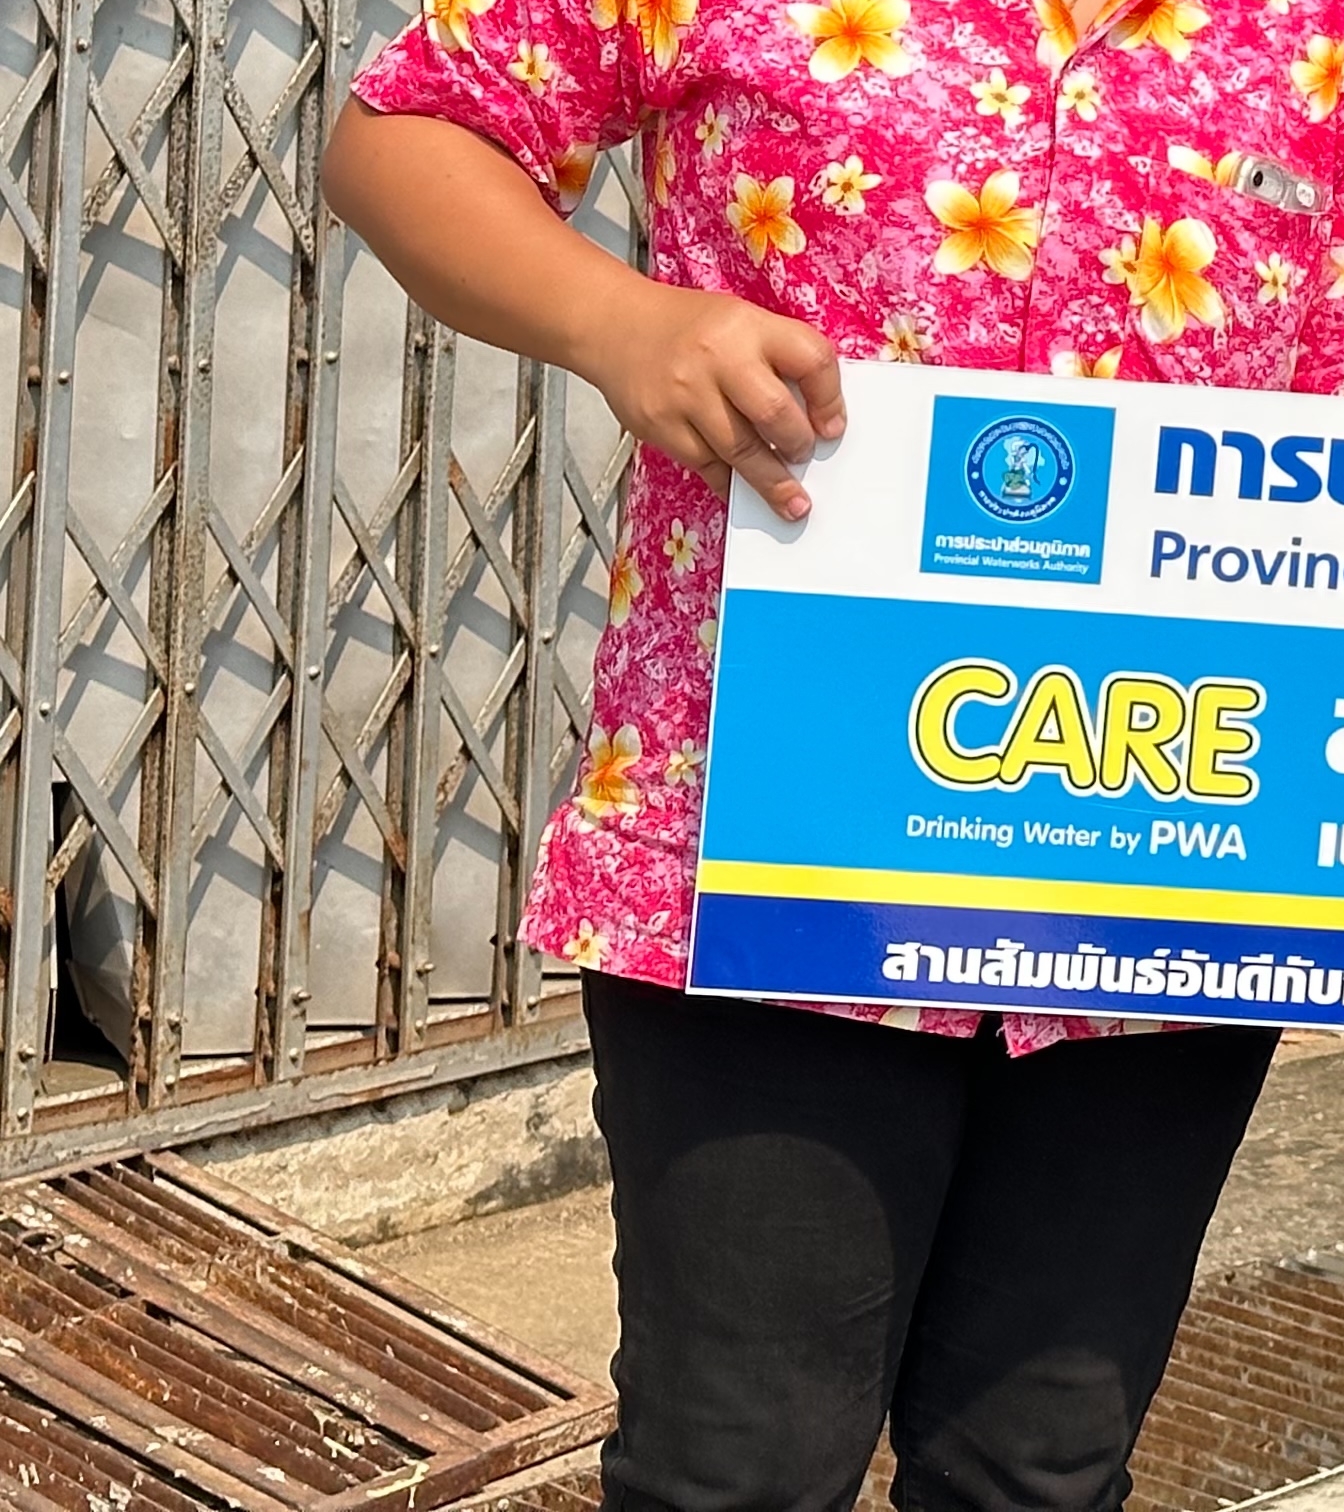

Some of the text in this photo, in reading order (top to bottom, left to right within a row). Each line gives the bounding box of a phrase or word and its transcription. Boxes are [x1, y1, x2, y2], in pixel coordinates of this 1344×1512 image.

[934, 553, 1089, 575] Provincial Waterworks Authority
[935, 534, 1091, 559] การประปาส่วนภูมิภาค
[908, 658, 1267, 806] CARE
[906, 814, 1248, 861] Drinking Water by PWA
